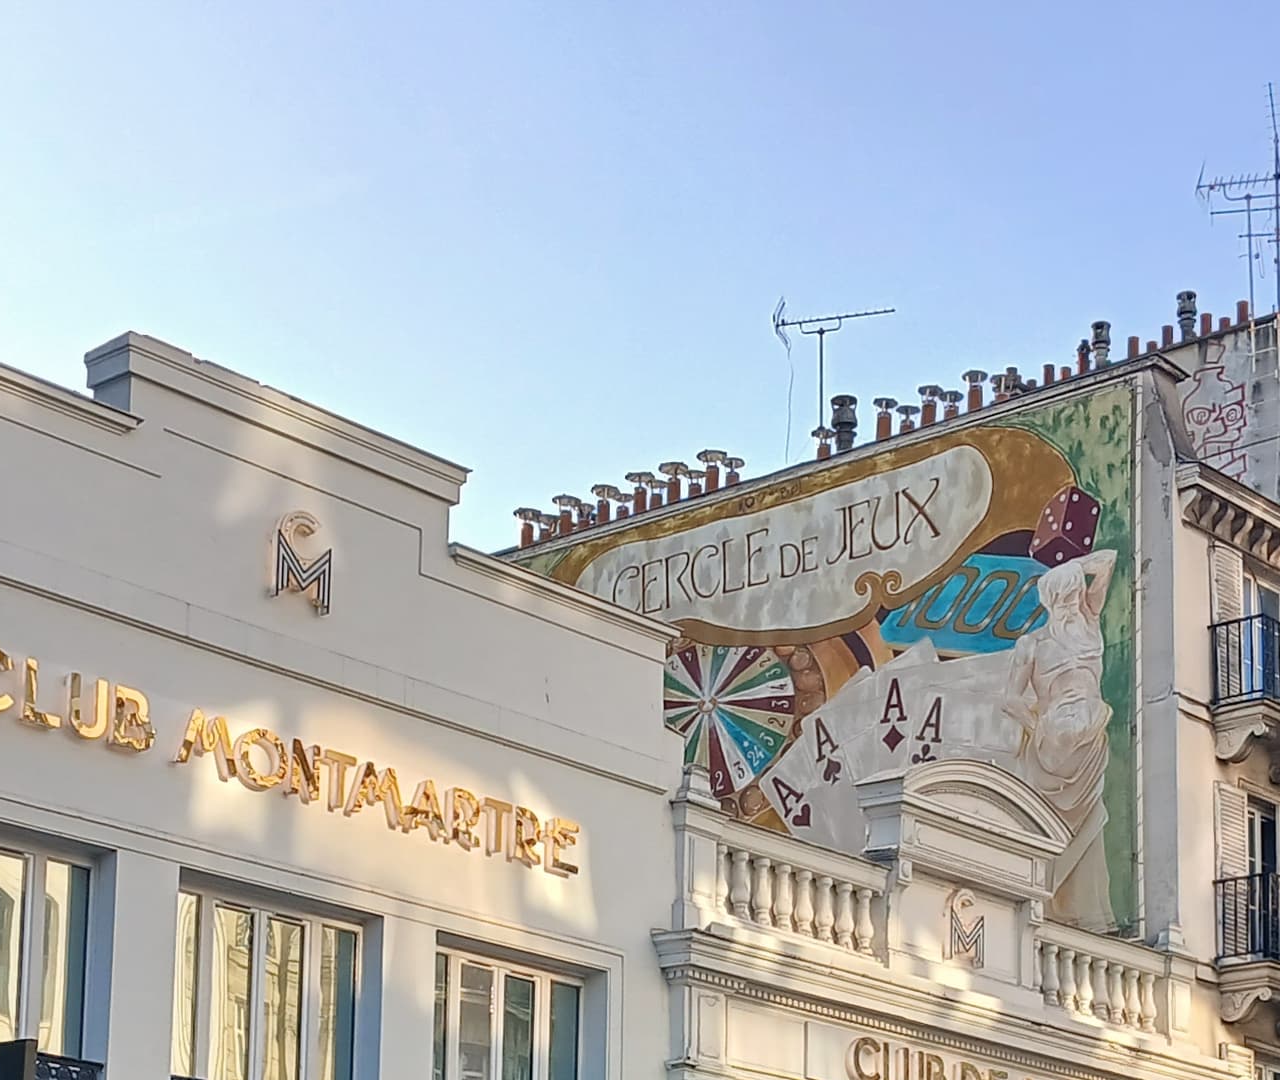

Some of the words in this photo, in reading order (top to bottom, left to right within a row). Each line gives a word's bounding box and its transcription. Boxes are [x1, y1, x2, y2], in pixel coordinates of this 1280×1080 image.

[613, 527, 770, 615] CERCLE
[779, 536, 819, 578] DE
[826, 478, 941, 566] JEUX
[880, 678, 907, 724] A
[915, 697, 942, 743] A
[815, 717, 839, 763] A
[170, 706, 581, 877] MONTMARTRE
[771, 776, 804, 818] A
